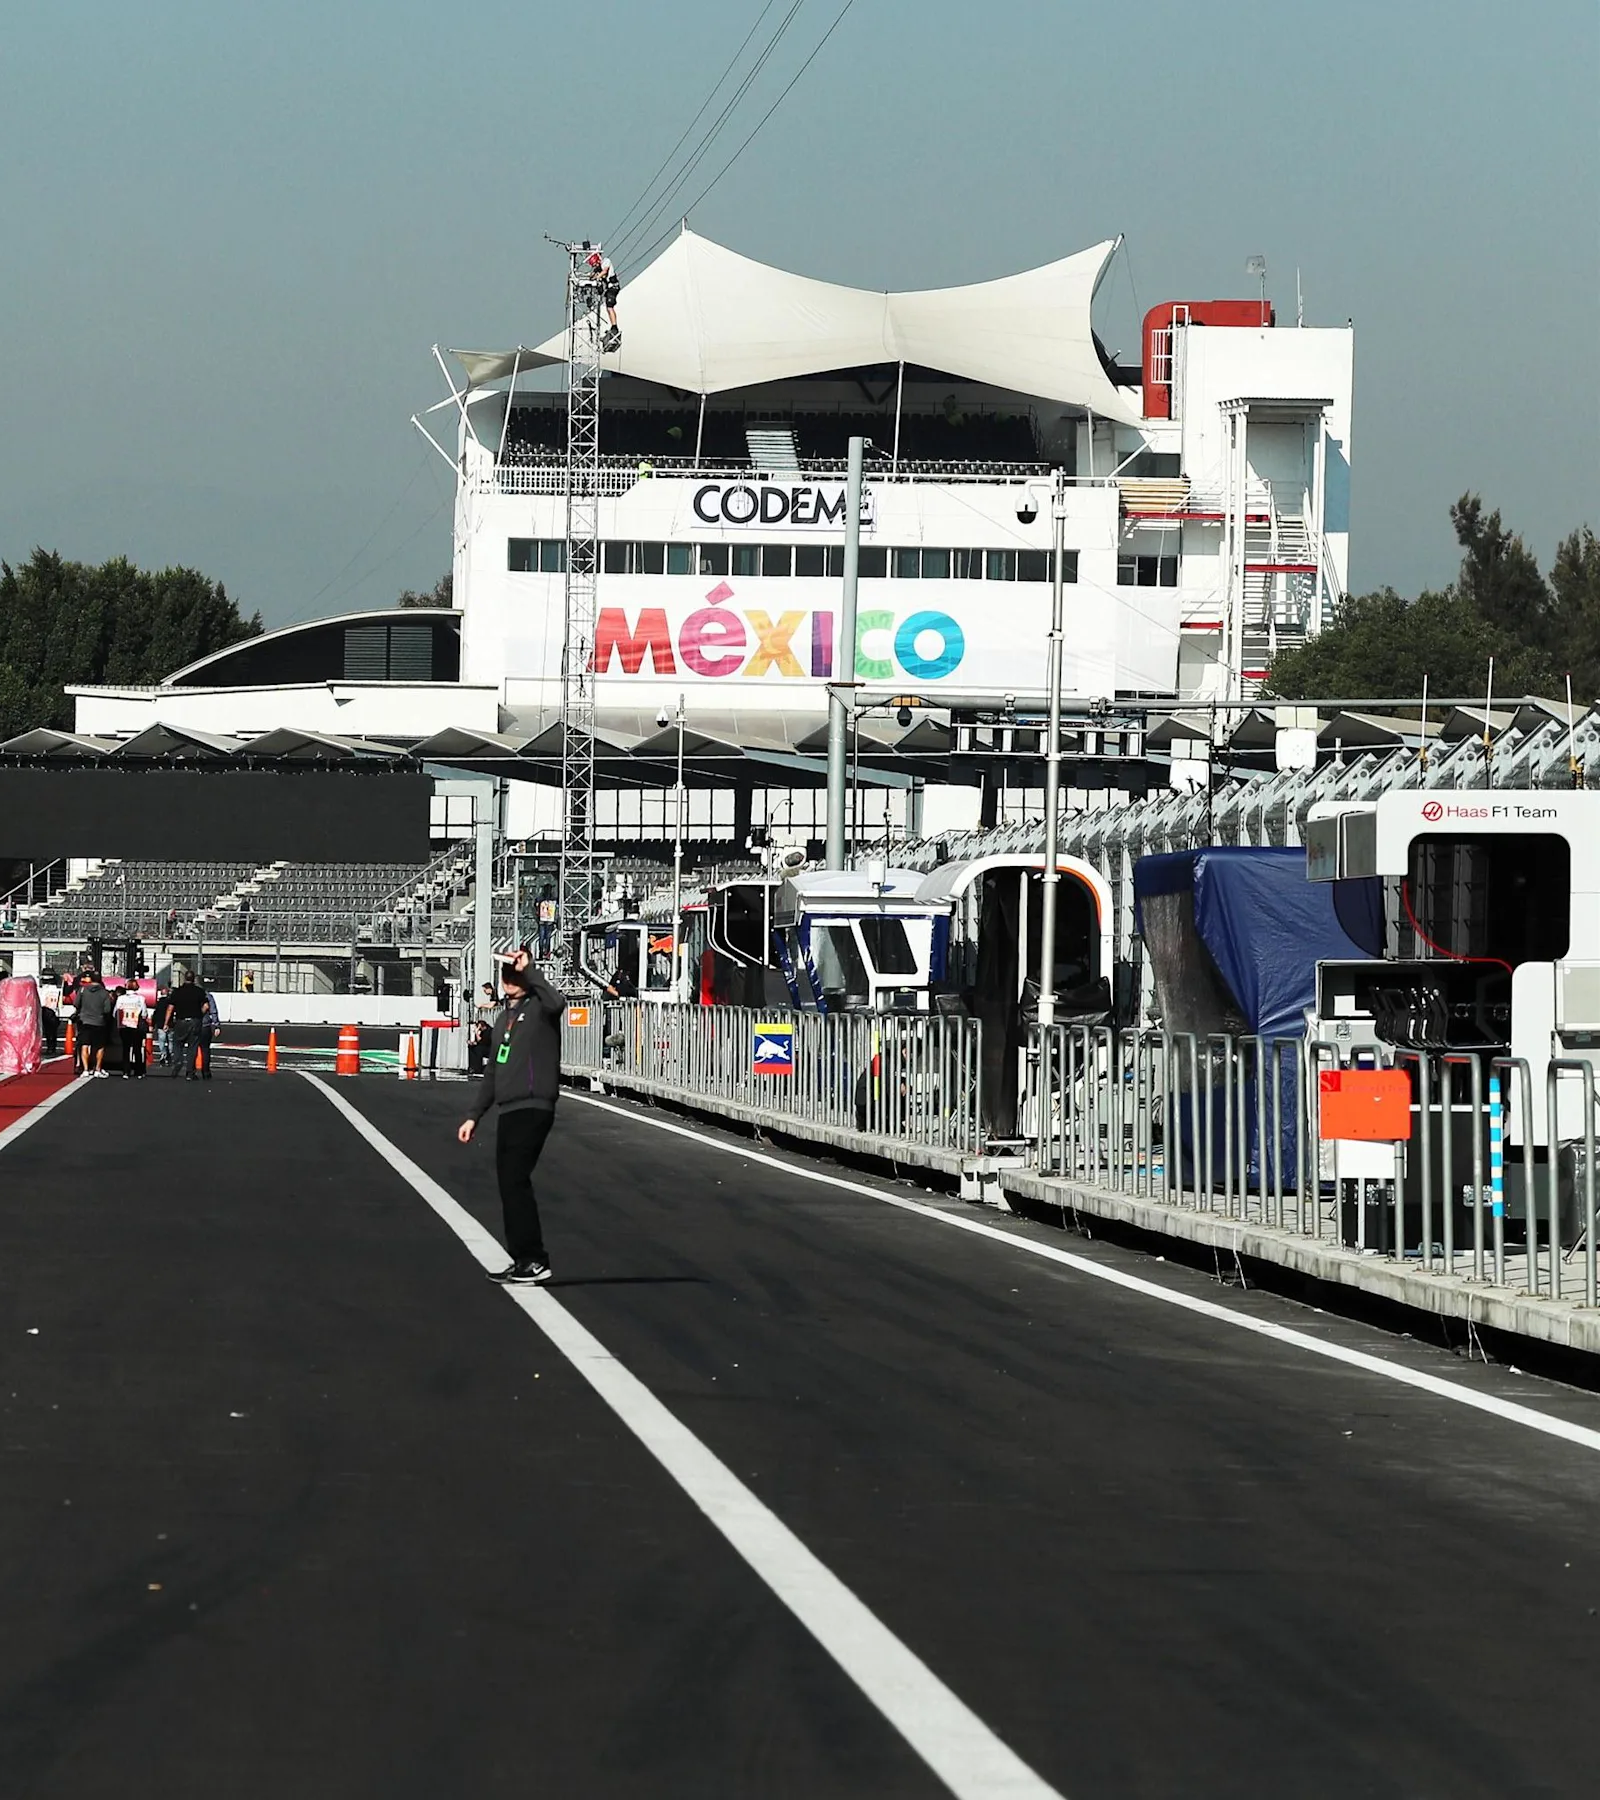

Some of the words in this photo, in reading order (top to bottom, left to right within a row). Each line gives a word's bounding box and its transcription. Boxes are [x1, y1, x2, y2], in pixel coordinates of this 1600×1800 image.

[1446, 805, 1488, 818] Haas
[1491, 805, 1508, 818] F1
[1513, 805, 1557, 818] Team
